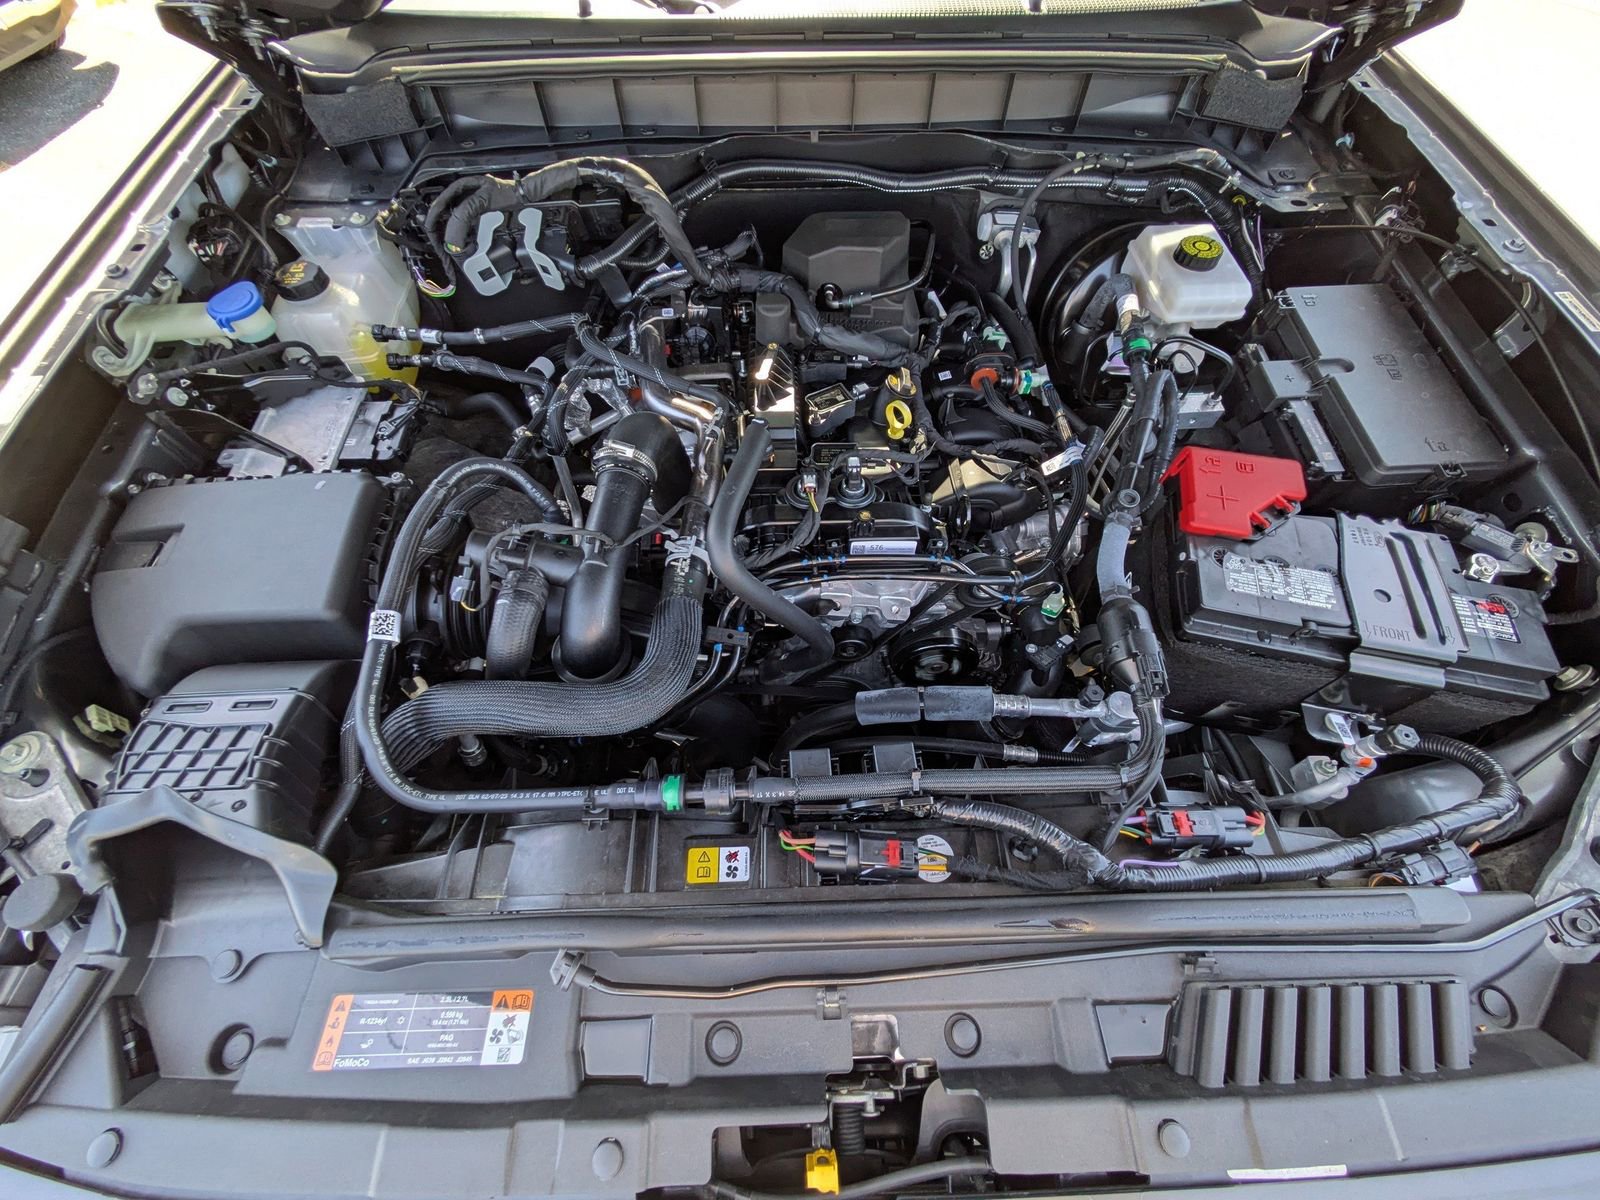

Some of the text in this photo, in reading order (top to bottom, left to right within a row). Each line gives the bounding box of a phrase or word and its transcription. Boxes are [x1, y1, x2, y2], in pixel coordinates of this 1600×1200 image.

[1372, 624, 1411, 642] FRONT
[616, 786, 627, 794] DOT
[333, 1057, 370, 1068] FoMoCo
